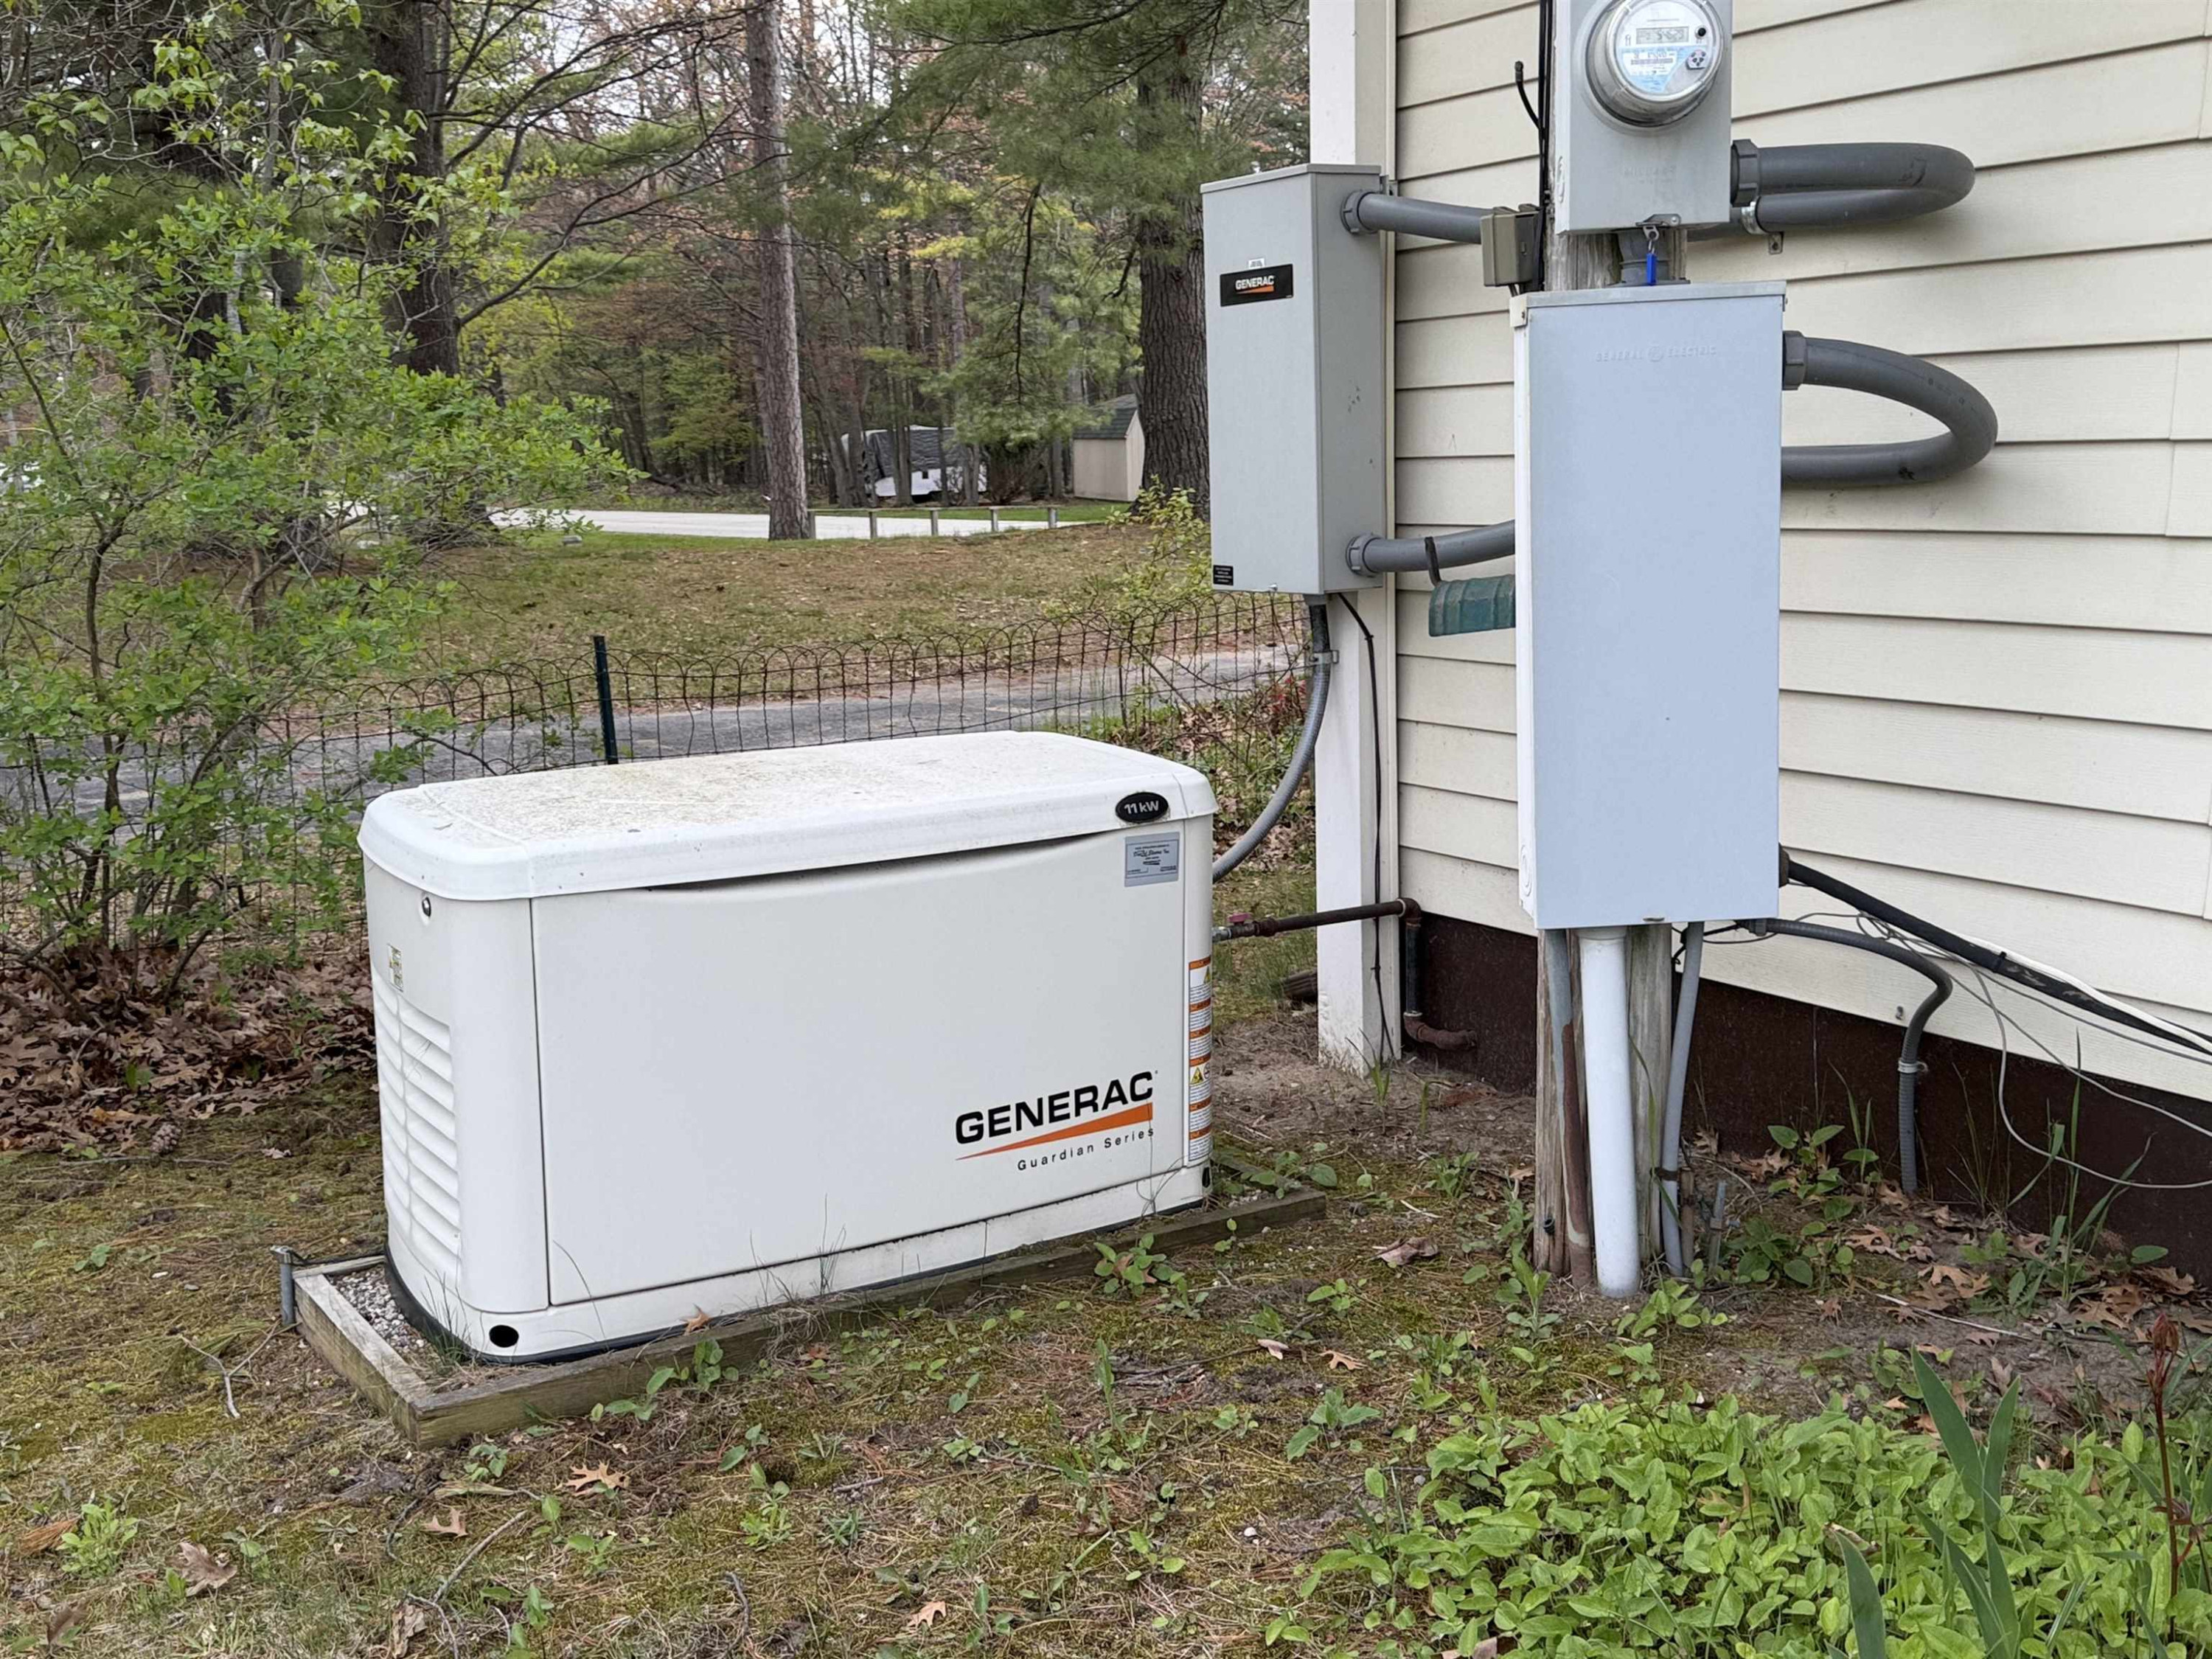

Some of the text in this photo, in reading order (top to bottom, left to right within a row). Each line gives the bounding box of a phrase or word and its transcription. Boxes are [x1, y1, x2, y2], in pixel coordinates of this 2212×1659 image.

[1235, 275, 1274, 290] GENERAC
[956, 1071, 1153, 1144] GENERAC
[1018, 1128, 1154, 1171] Guardian Series
